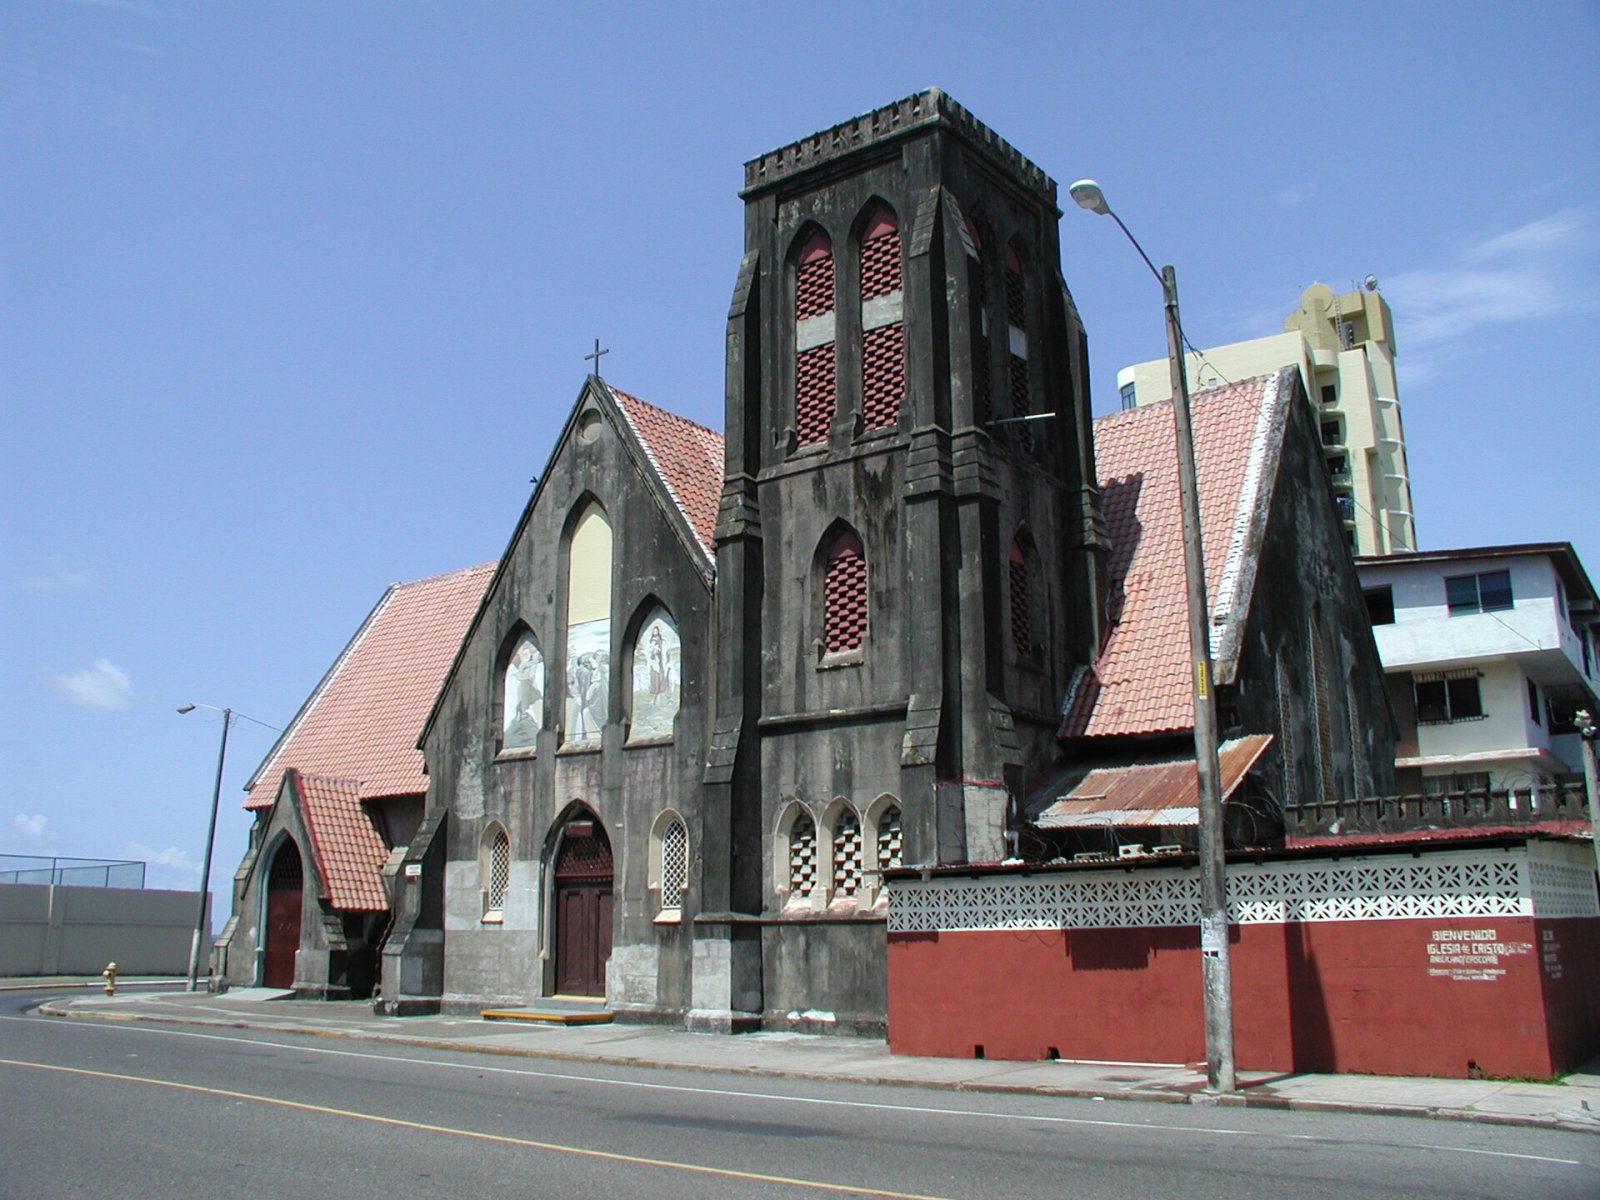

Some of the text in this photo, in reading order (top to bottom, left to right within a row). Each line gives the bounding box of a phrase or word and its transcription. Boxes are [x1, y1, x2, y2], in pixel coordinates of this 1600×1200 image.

[1432, 929, 1497, 941] BIENVENIDO
[1427, 943, 1461, 955] IGLESIA
[1472, 943, 1504, 955] CRISTO
